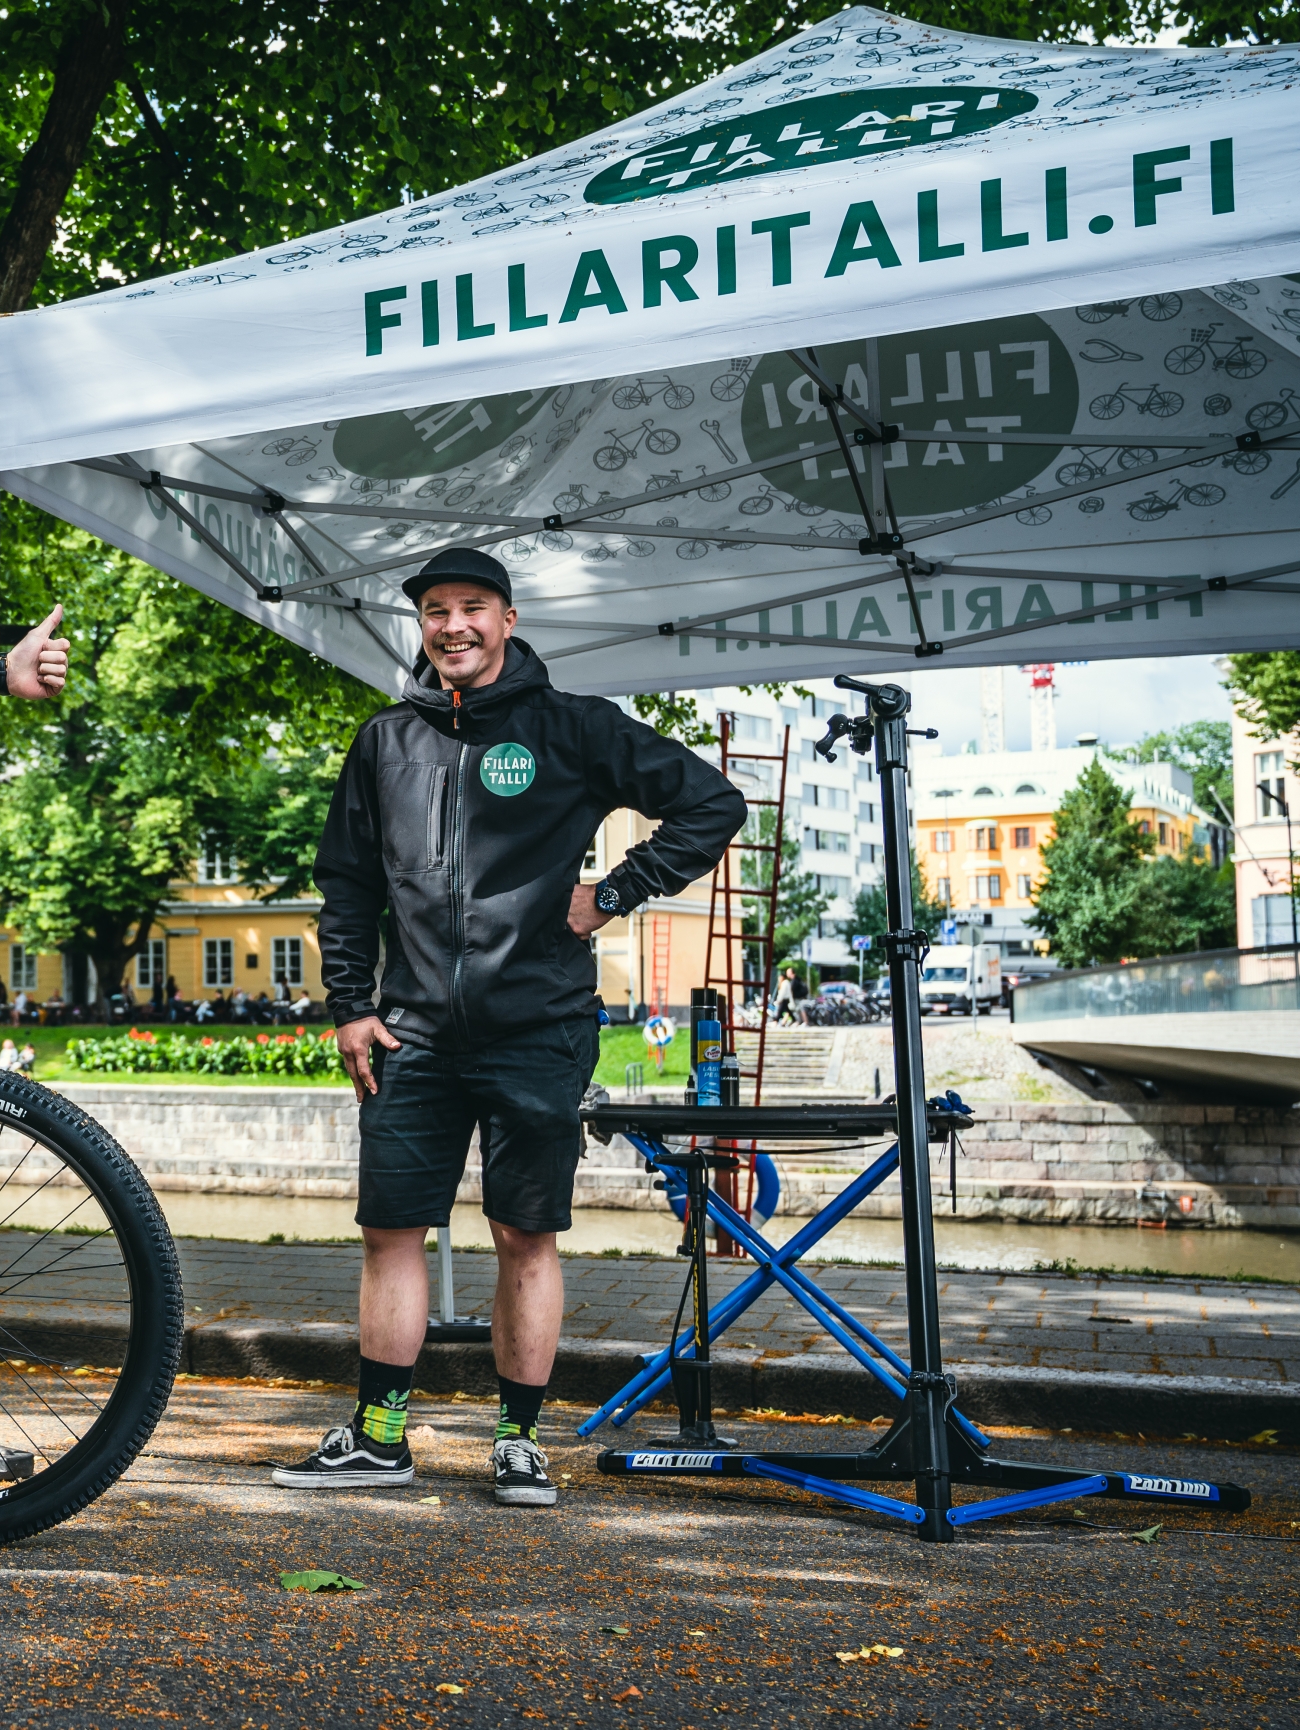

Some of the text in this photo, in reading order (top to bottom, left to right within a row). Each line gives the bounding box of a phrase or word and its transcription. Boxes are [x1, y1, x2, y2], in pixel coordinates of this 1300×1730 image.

[620, 93, 999, 180] FILLARI
[649, 120, 956, 188] TALLI
[364, 137, 1235, 357] FILLARITALLI.FI
[483, 757, 532, 770] FILLARI
[488, 772, 527, 784] TALLI
